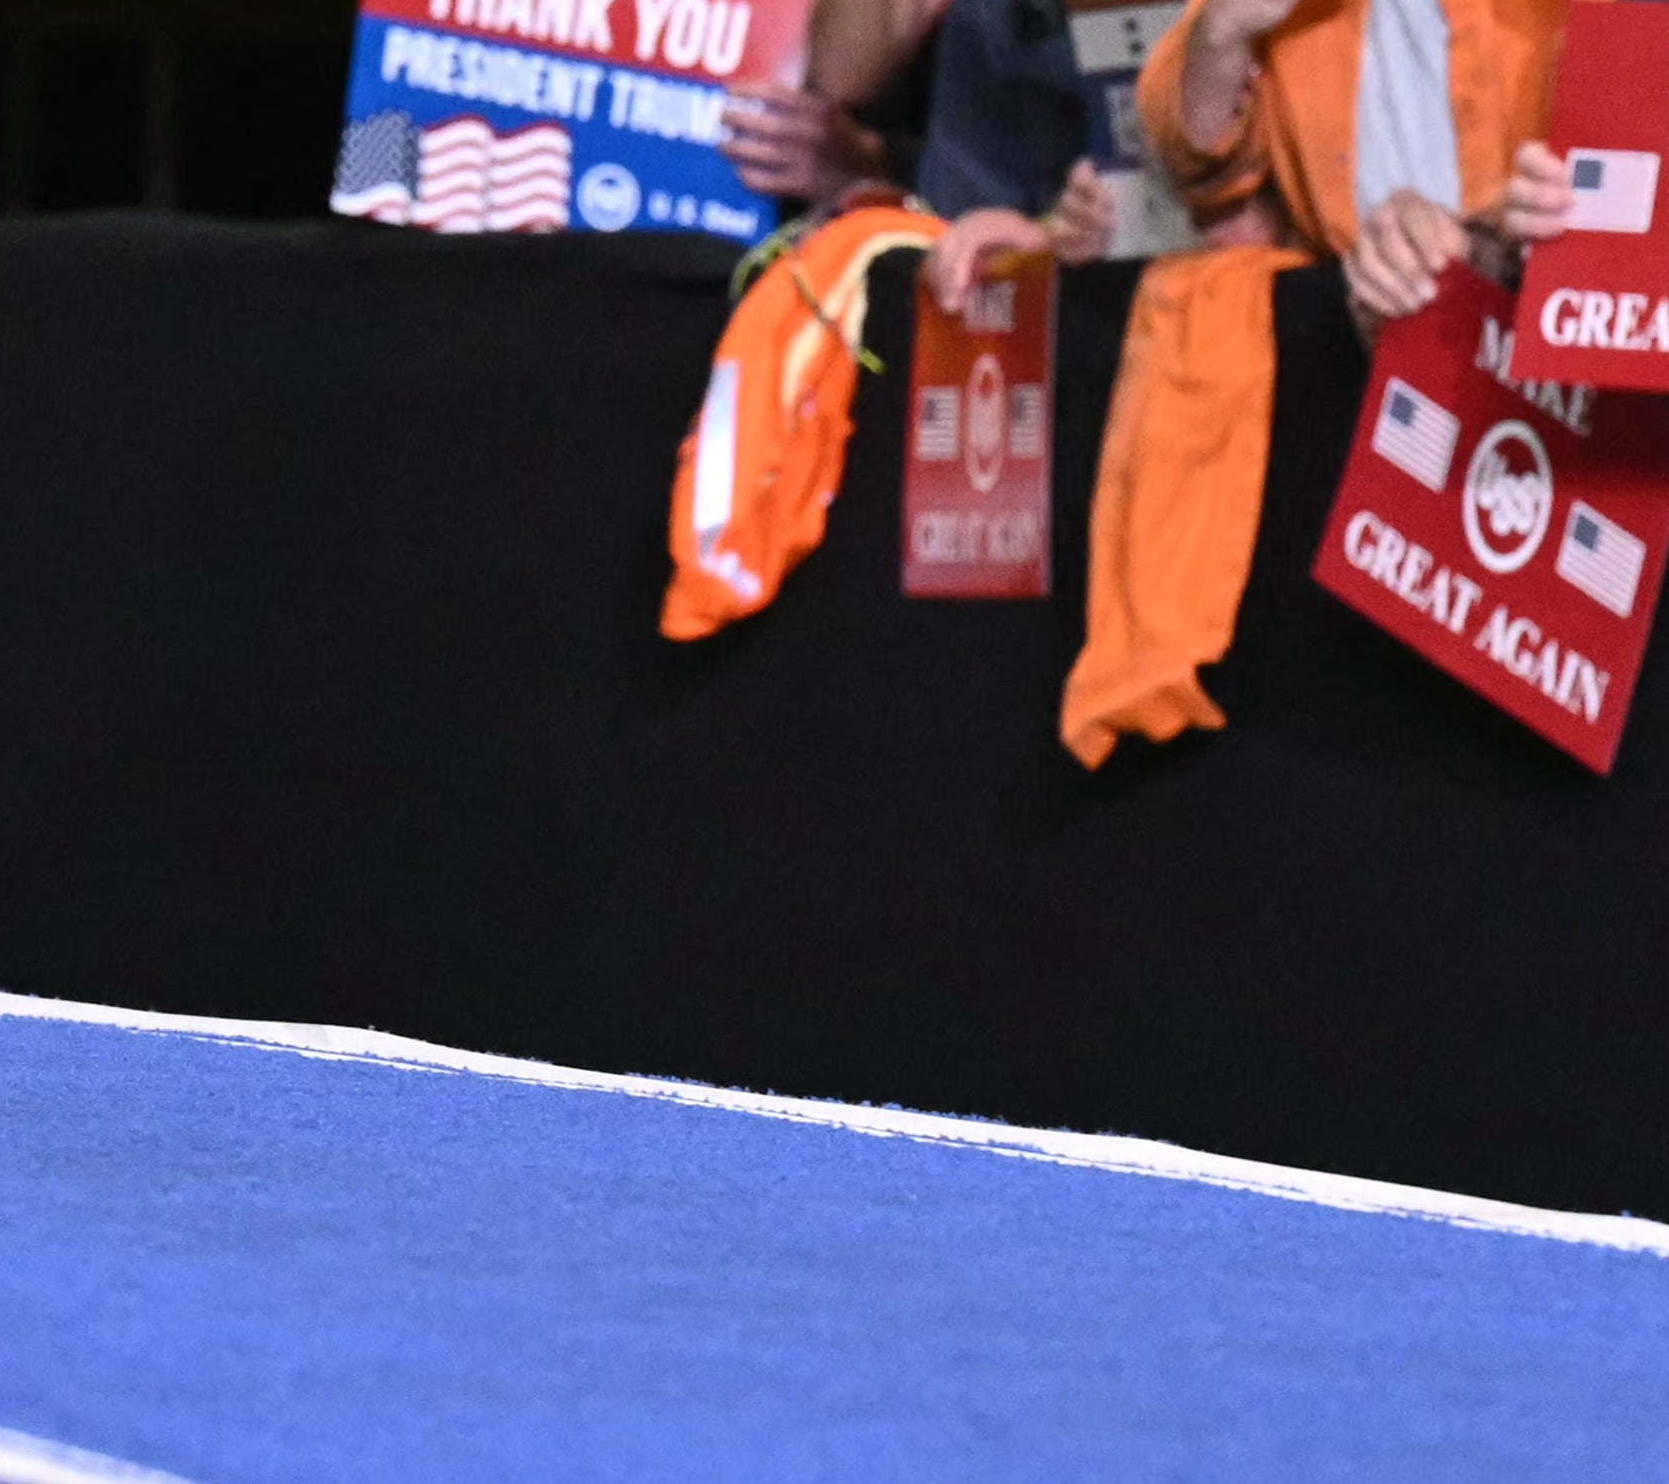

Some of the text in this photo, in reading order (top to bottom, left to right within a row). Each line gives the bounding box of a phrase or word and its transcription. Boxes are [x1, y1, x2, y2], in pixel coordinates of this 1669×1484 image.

[380, 24, 732, 149] PRESIDENT TRUM
[1342, 509, 1612, 725] GREAT AGAIN
